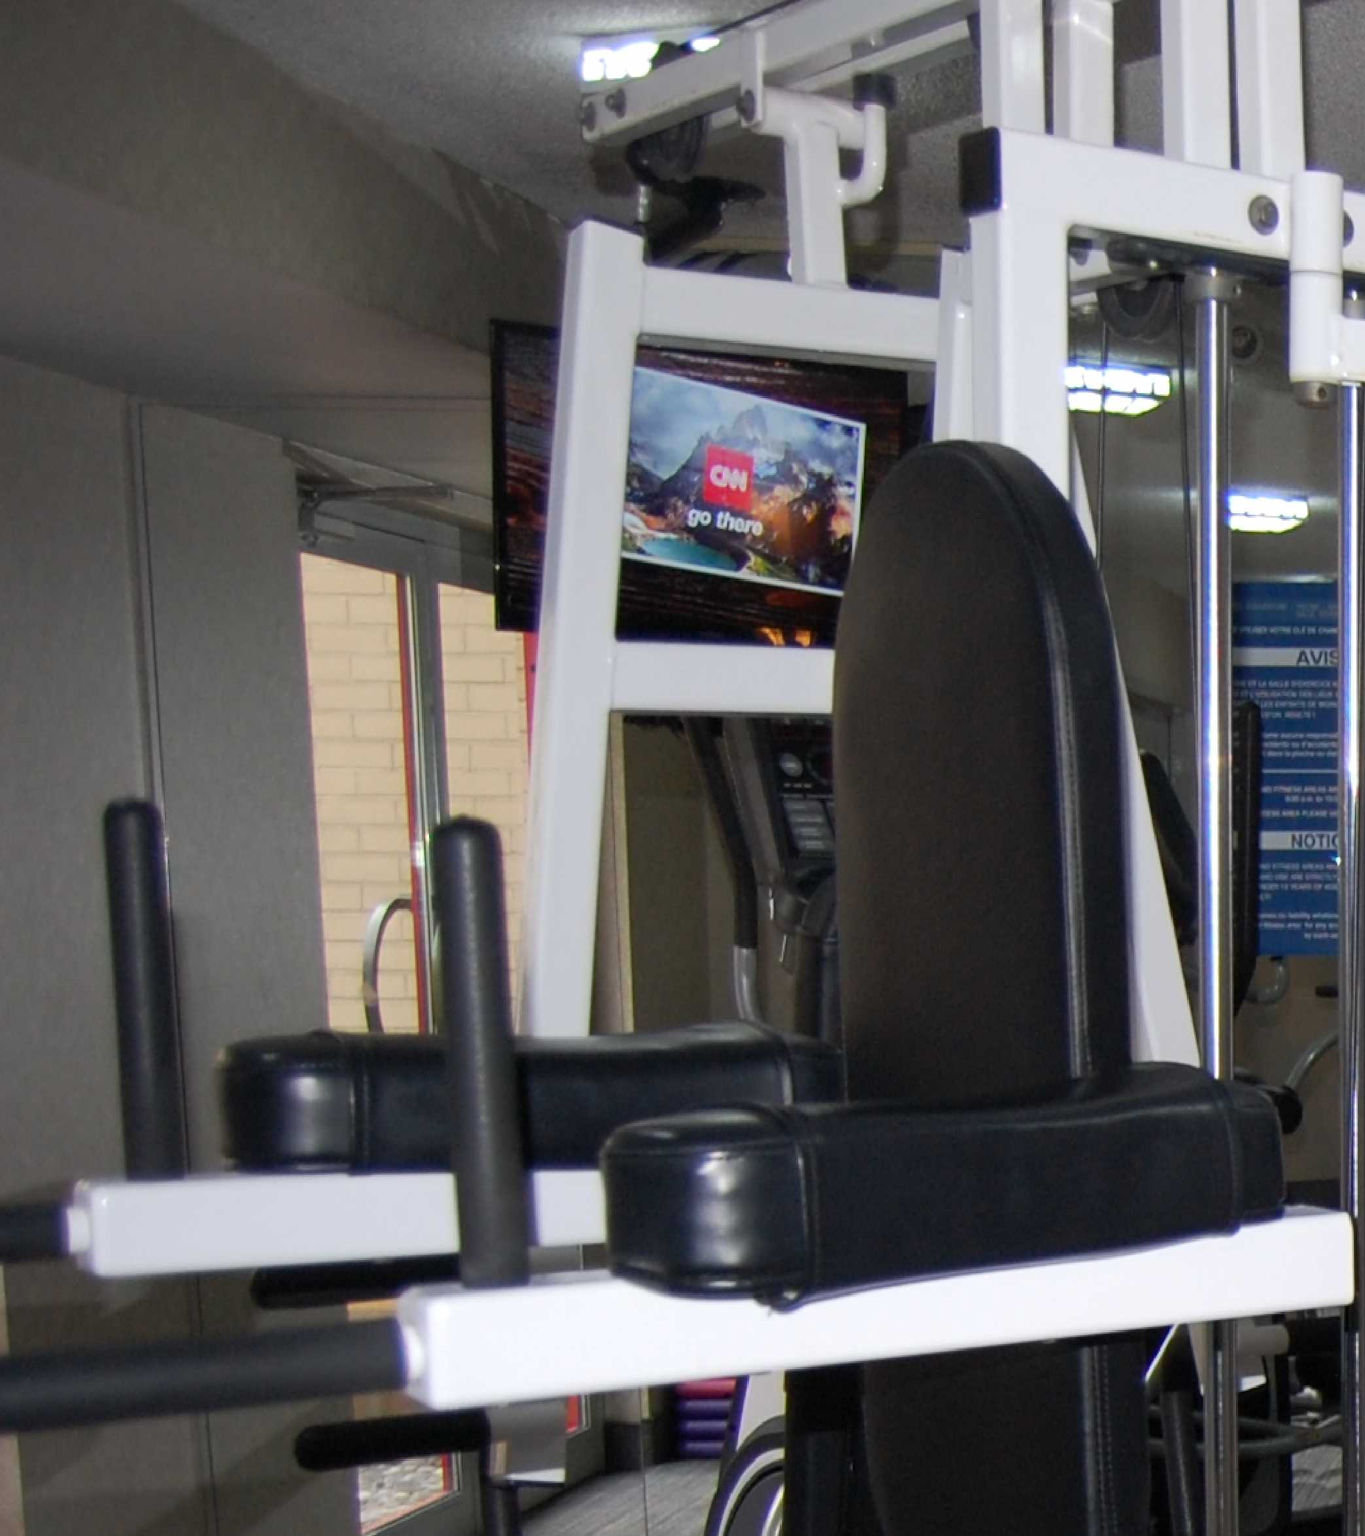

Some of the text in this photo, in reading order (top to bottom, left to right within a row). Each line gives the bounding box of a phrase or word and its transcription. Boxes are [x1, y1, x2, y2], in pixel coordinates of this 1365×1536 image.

[709, 464, 749, 493] CNN
[688, 509, 764, 537] go there
[1296, 649, 1340, 666] AVIS
[1292, 833, 1339, 849] NOTIC
